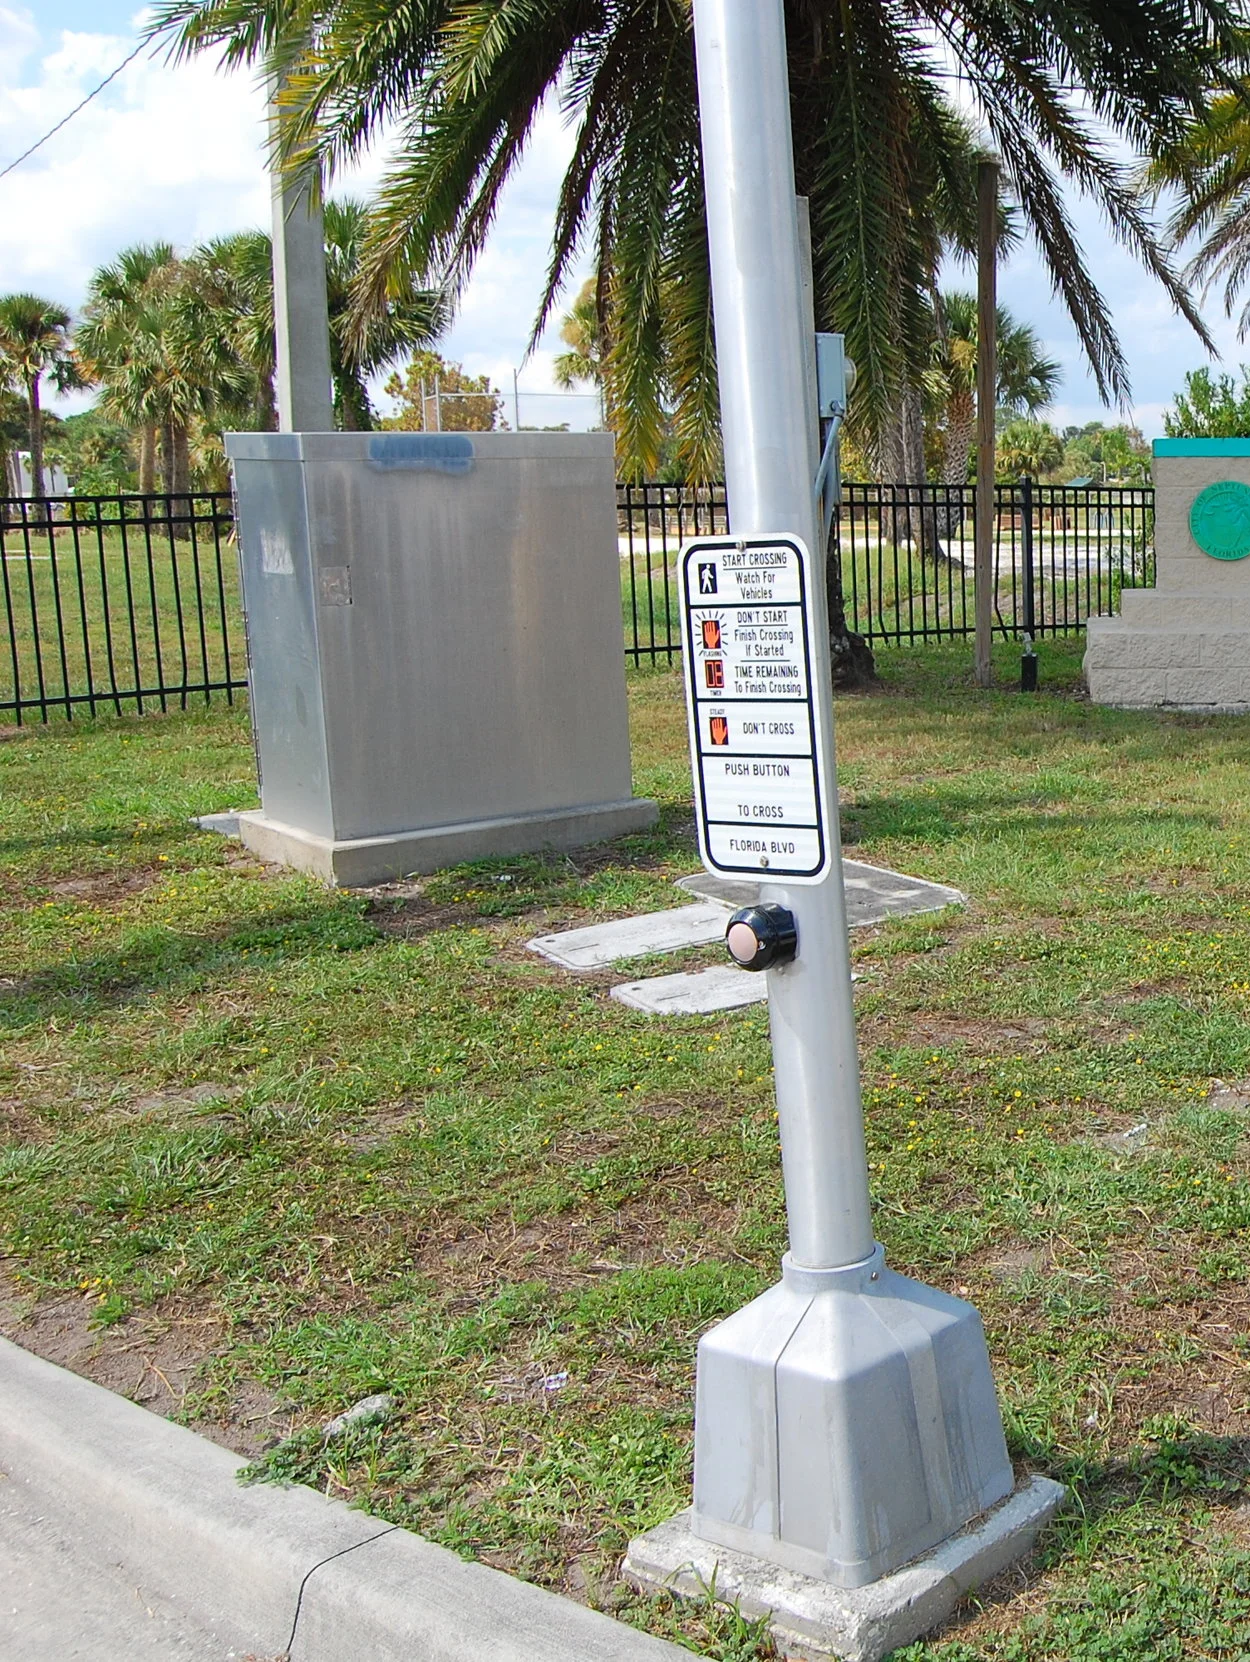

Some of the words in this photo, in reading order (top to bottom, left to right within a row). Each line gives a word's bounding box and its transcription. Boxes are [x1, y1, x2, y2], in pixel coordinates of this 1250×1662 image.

[722, 554, 746, 566] START
[749, 552, 787, 565] CROSSING
[735, 571, 760, 584] Watch
[763, 570, 775, 584] For
[740, 587, 773, 600] Vehicles
[737, 610, 760, 623] DON'T
[763, 610, 788, 623] START
[734, 628, 757, 641] Finish
[759, 628, 794, 644] Crossing
[745, 644, 751, 656] If
[754, 644, 784, 657] Started
[734, 665, 753, 678] TIME
[756, 665, 799, 678] REMAINING
[734, 681, 743, 693] To
[745, 680, 767, 693] Finish
[769, 680, 802, 696] Crossing
[743, 722, 766, 735] DON'T
[769, 722, 795, 735] CROSS
[725, 763, 750, 776] PUSH
[753, 764, 790, 777] BUTTON
[737, 804, 750, 817] TO
[752, 805, 784, 818] CROSS
[729, 838, 767, 852] FLORIDA
[770, 841, 795, 854] BLVD
